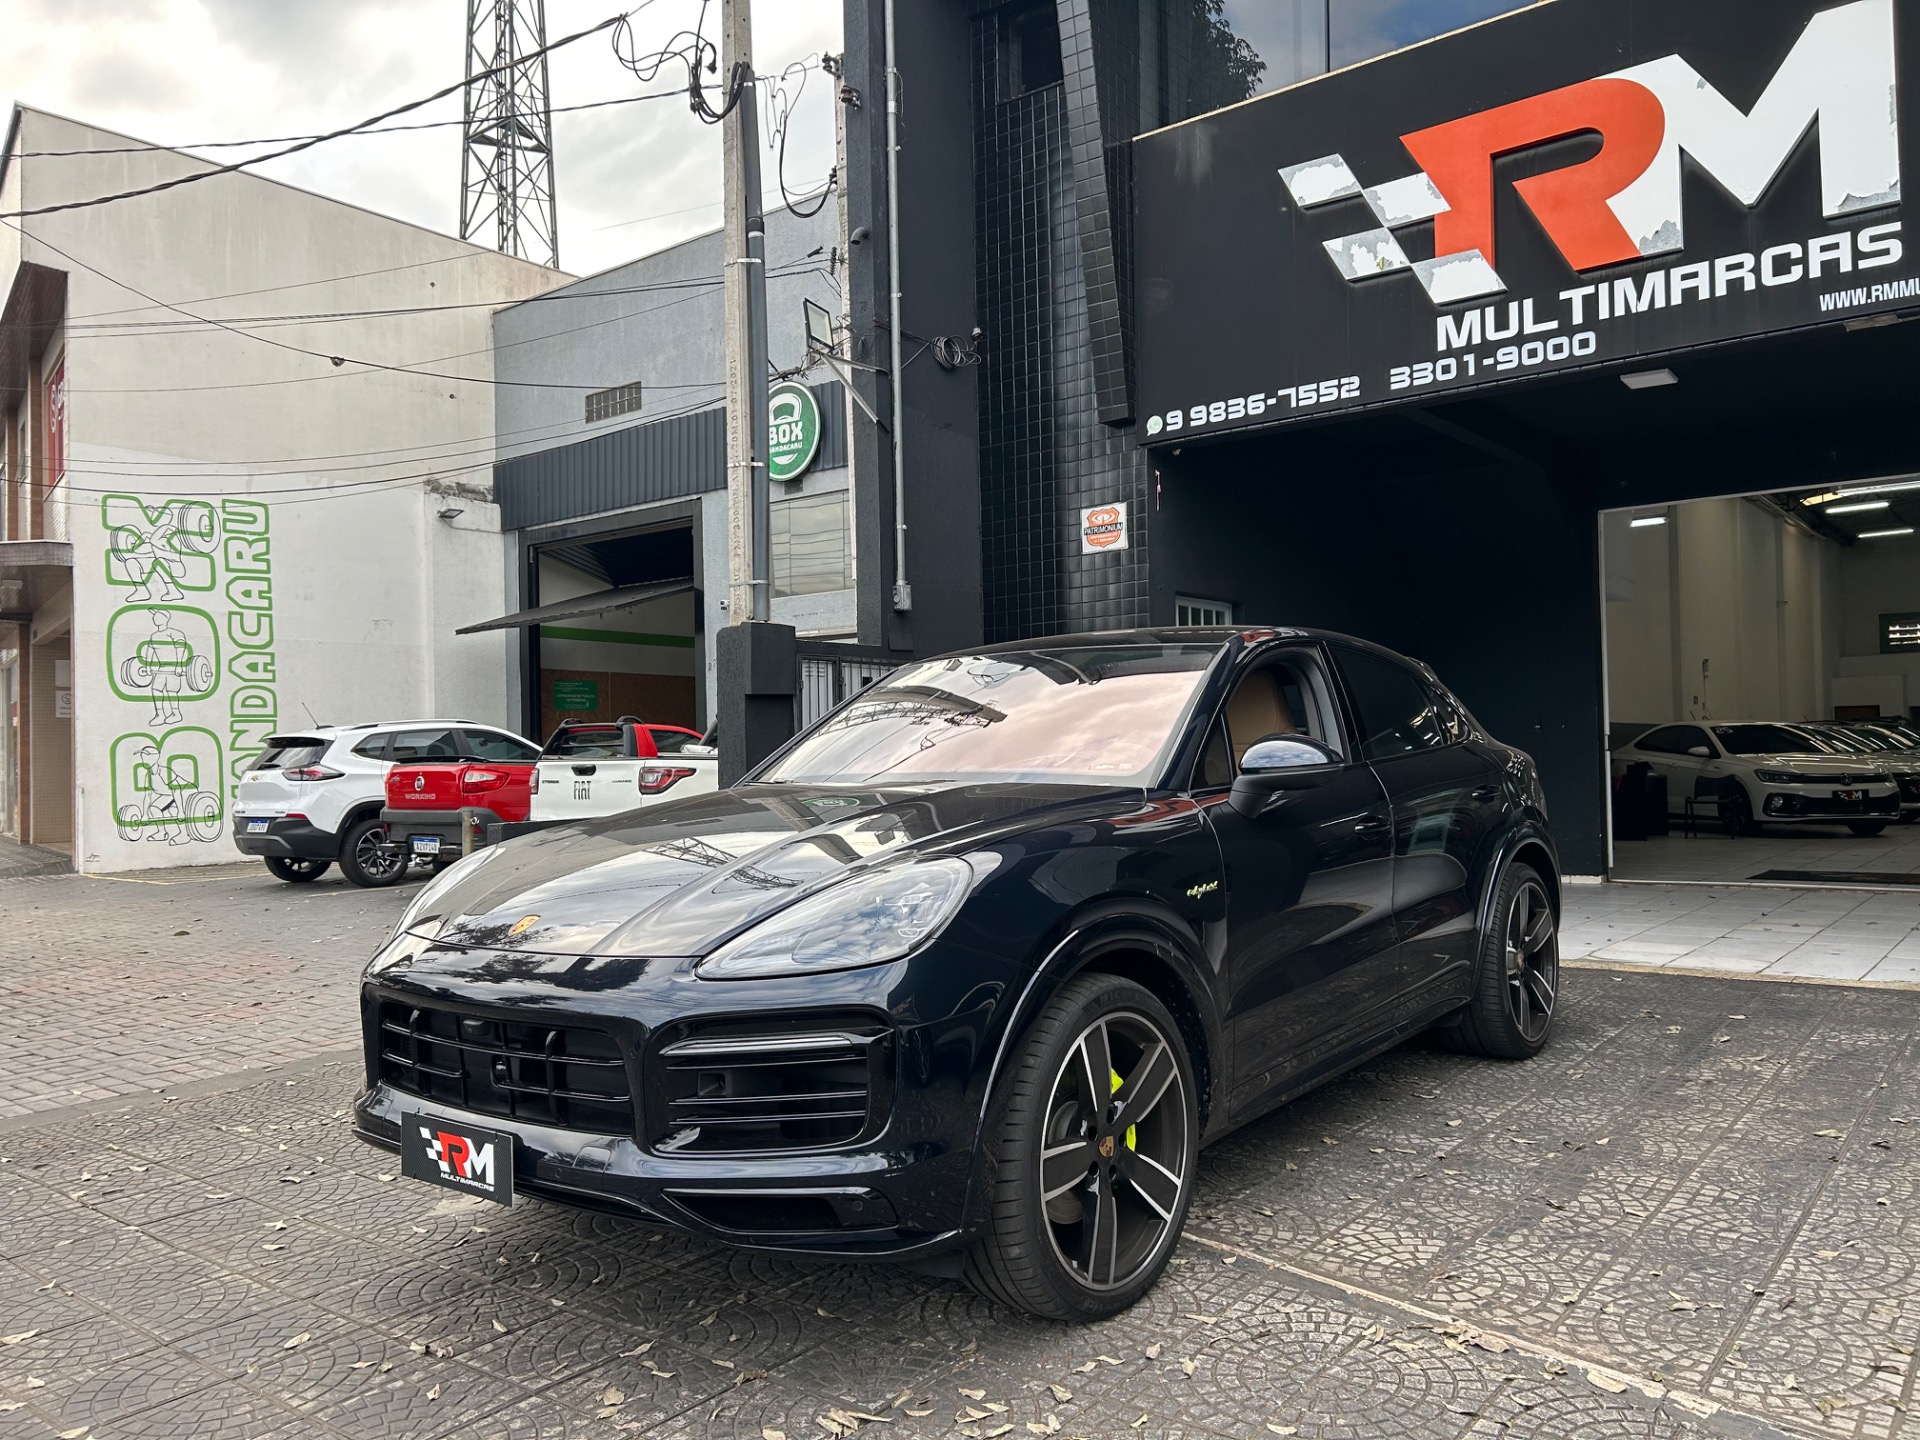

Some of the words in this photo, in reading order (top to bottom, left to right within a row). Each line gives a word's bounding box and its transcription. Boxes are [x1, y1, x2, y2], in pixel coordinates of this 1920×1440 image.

[1400, 0, 1902, 271] RM
[1436, 221, 1903, 352] MULTIMARCAS
[1389, 330, 1597, 391] 3301-9000
[1166, 409, 1184, 432] 9
[1189, 375, 1361, 427] 9836-7552
[769, 421, 803, 446] BOX
[1084, 522, 1123, 535] PATRIMONIUM
[101, 493, 224, 827] BOX
[222, 498, 278, 799] NDACARU
[573, 780, 592, 800] FIAT
[437, 1131, 495, 1185] RM
[440, 1172, 495, 1192] MULTIMARCAS
